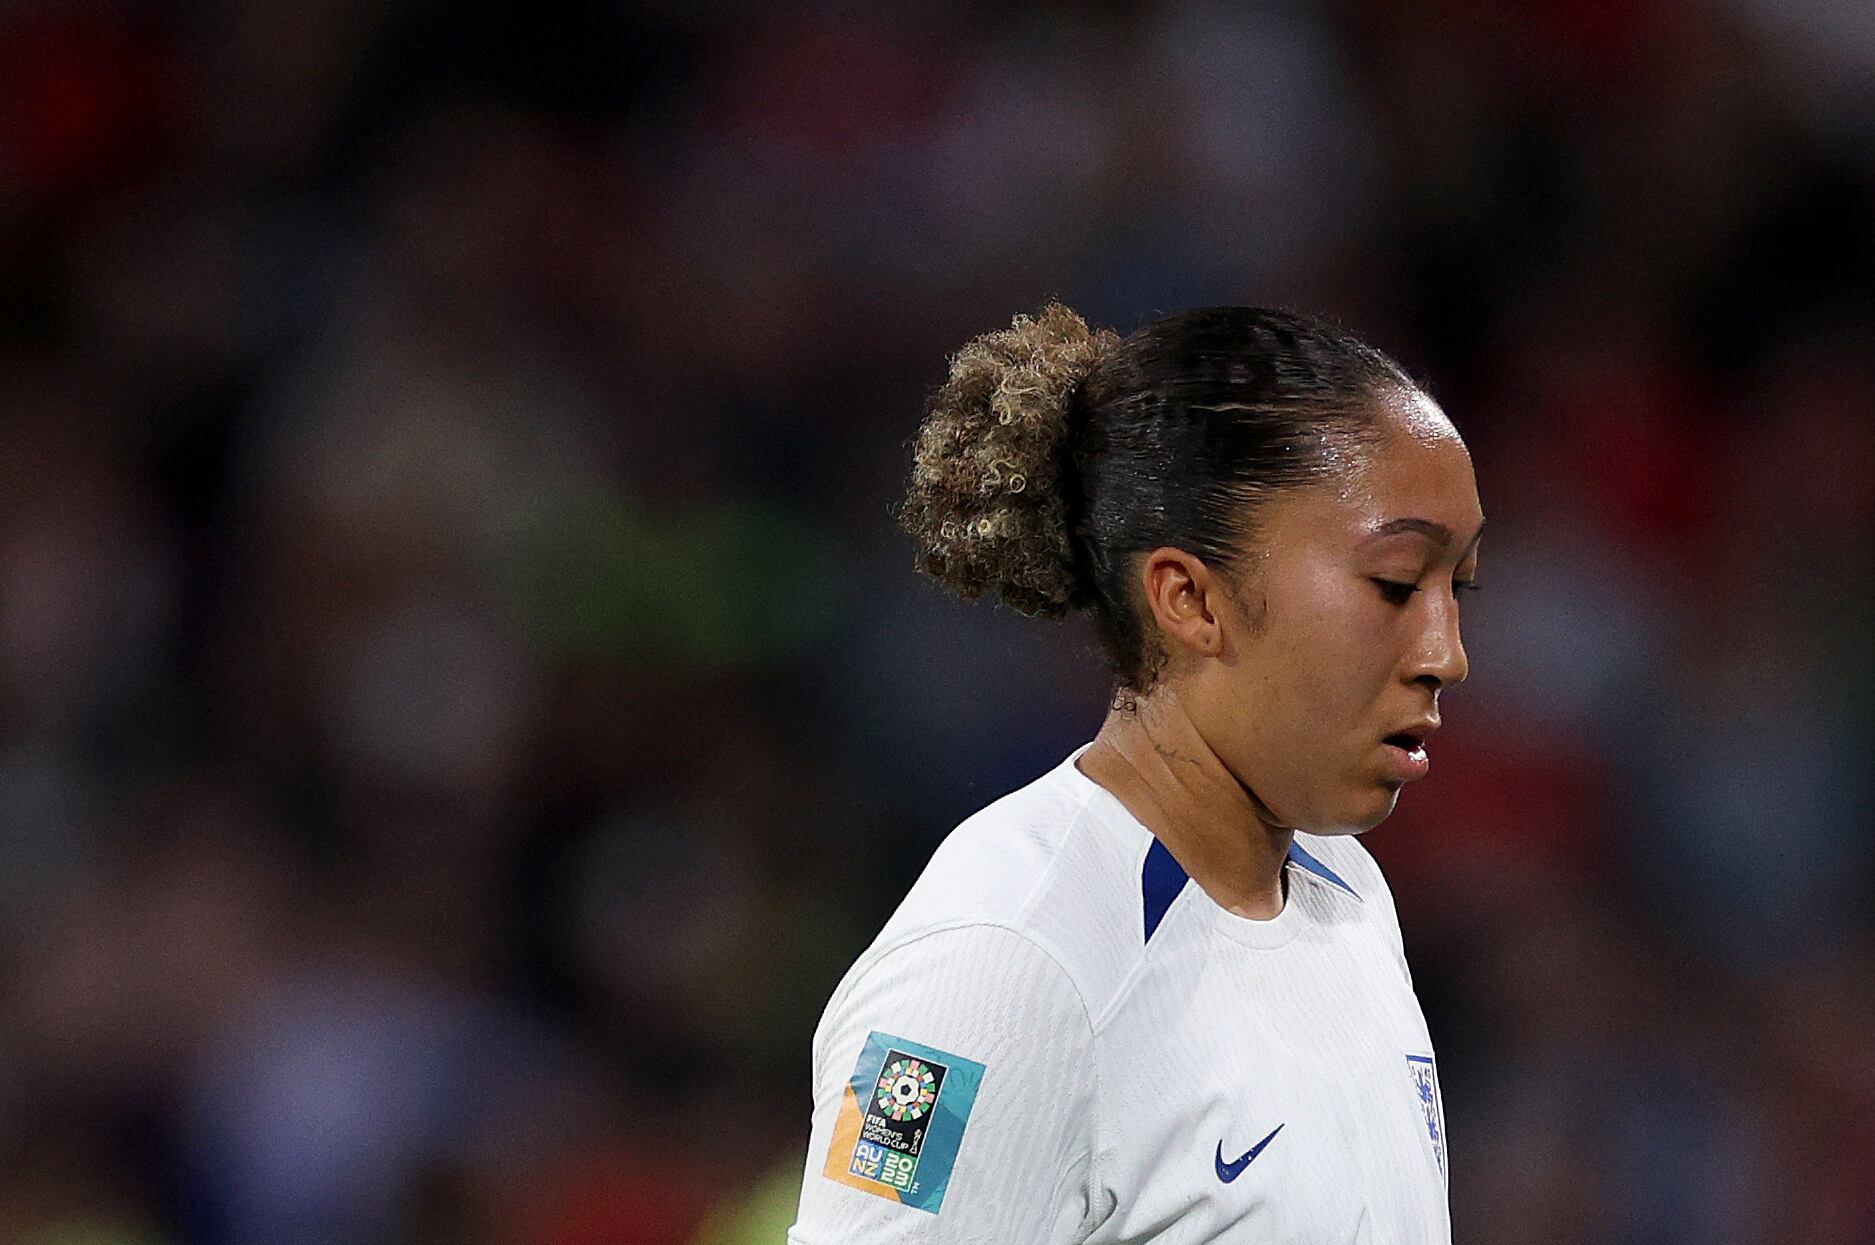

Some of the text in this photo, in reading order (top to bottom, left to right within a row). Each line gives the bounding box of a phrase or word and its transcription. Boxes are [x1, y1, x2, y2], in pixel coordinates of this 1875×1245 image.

[866, 1114, 886, 1128] FIFA
[863, 1131, 909, 1150] WORLD CUP
[856, 1145, 883, 1162] AU
[853, 1158, 878, 1176] NZ
